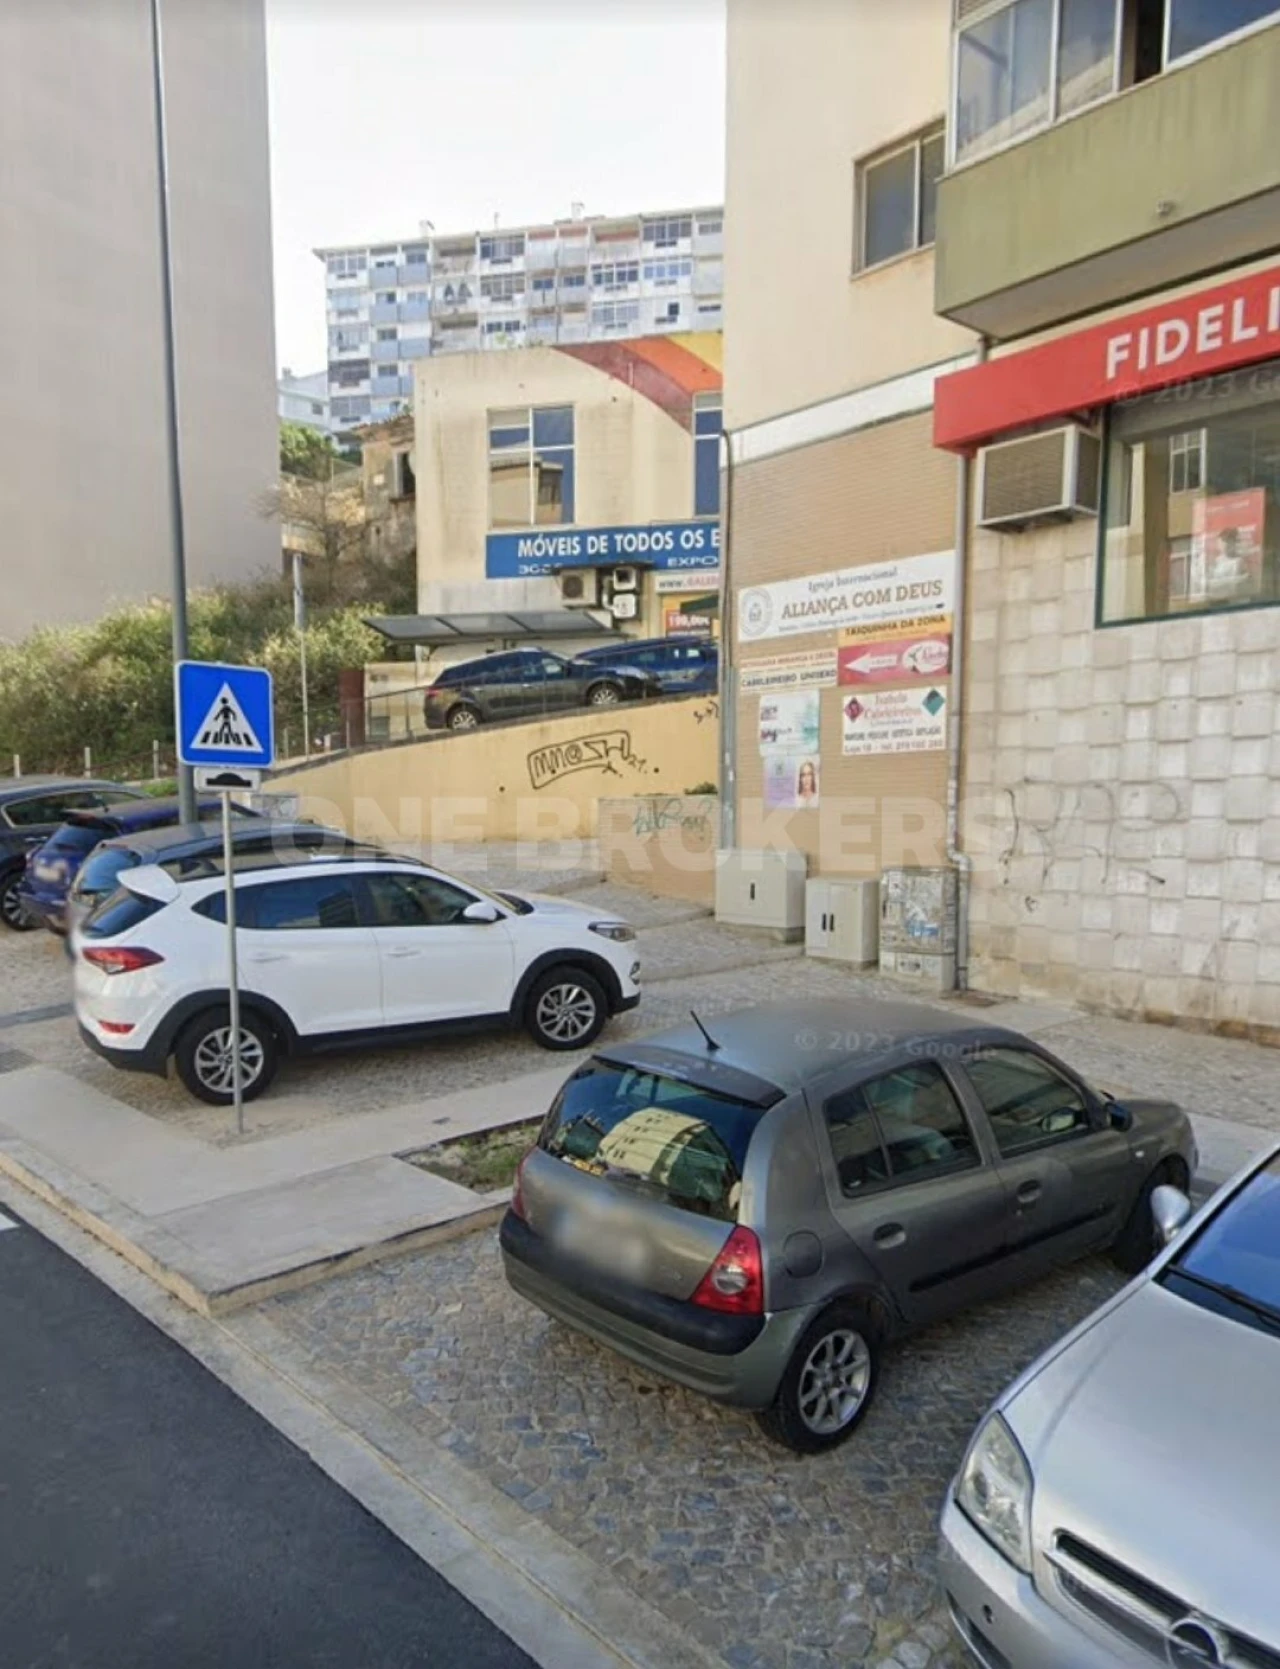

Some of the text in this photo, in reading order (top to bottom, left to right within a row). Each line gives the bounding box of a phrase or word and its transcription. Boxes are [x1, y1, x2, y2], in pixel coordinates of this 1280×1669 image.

[1107, 286, 1280, 380] FIDELI
[517, 534, 581, 558] MÓVEIS
[587, 534, 609, 555] DE
[614, 530, 674, 553] TODOS
[680, 529, 705, 549] OS
[781, 595, 849, 620] ALIANÇA
[852, 587, 892, 608] COM
[895, 579, 943, 603] DEUS
